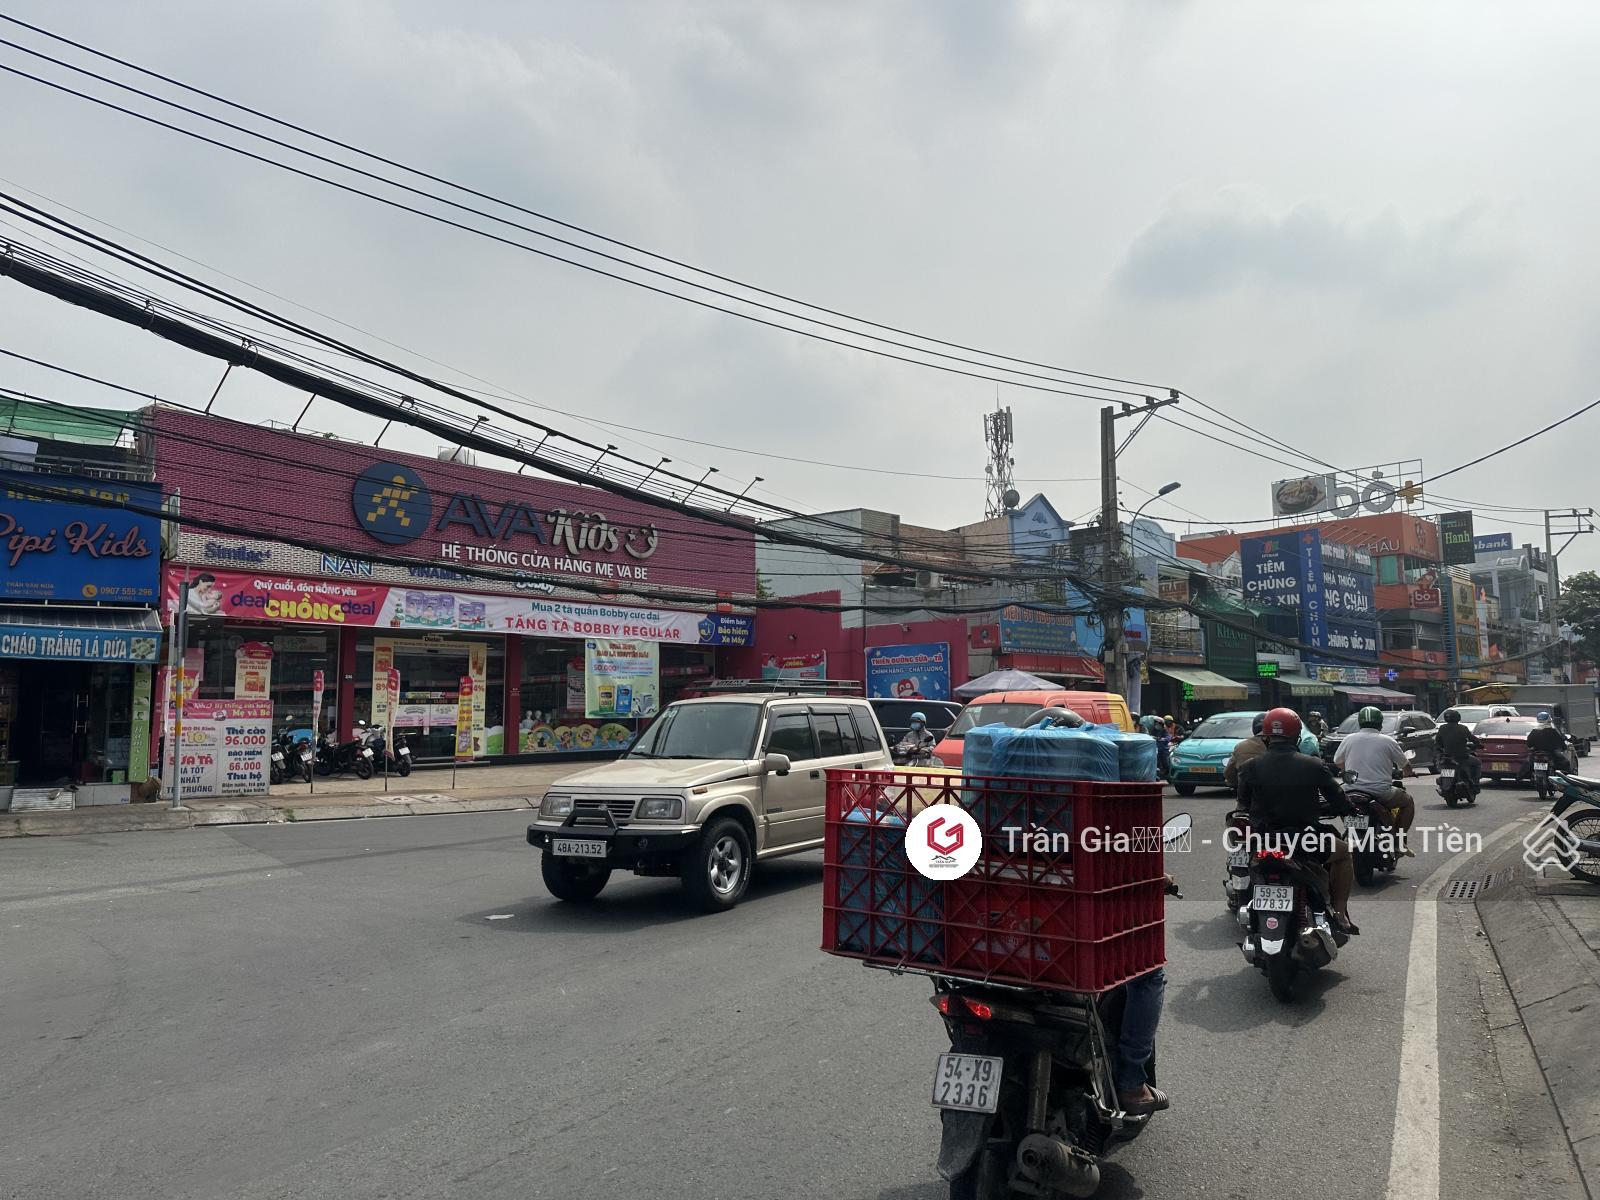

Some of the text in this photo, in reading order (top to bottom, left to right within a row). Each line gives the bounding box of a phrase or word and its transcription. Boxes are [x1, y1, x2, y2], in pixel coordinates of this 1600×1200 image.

[436, 491, 619, 555] AVA Kids
[65, 520, 153, 559] Kids
[320, 553, 374, 576] NAN
[441, 541, 461, 562] HỆ
[466, 544, 518, 567] THỐNG
[521, 548, 551, 570] CỬA
[554, 554, 591, 574] HÀNG
[595, 562, 614, 578] MẸ
[1256, 559, 1285, 575] TIÊM
[1247, 575, 1297, 592] CHỦNG
[1338, 572, 1357, 590] THUỐC
[231, 590, 375, 623] deal CHỒNG deal
[1278, 594, 1301, 606] XIN
[1344, 589, 1369, 614] CHÂU
[532, 602, 553, 612] Mua
[554, 604, 561, 613] 2
[600, 607, 628, 620] Bobby
[573, 621, 619, 635] BOBBY
[623, 625, 680, 639] REGULAR
[2, 631, 37, 655] CHÁO
[40, 630, 82, 657] TRẮNG
[226, 725, 266, 735] Thẻ cào
[225, 735, 266, 745] 96.000
[229, 761, 261, 771] 66.000
[226, 771, 262, 781] Thu hộ
[557, 842, 602, 855] 48A-213.52
[1260, 888, 1288, 899] 59-S3
[1256, 898, 1291, 911] 078.37
[944, 1056, 993, 1083] 54-X9
[939, 1081, 990, 1108] 2336
